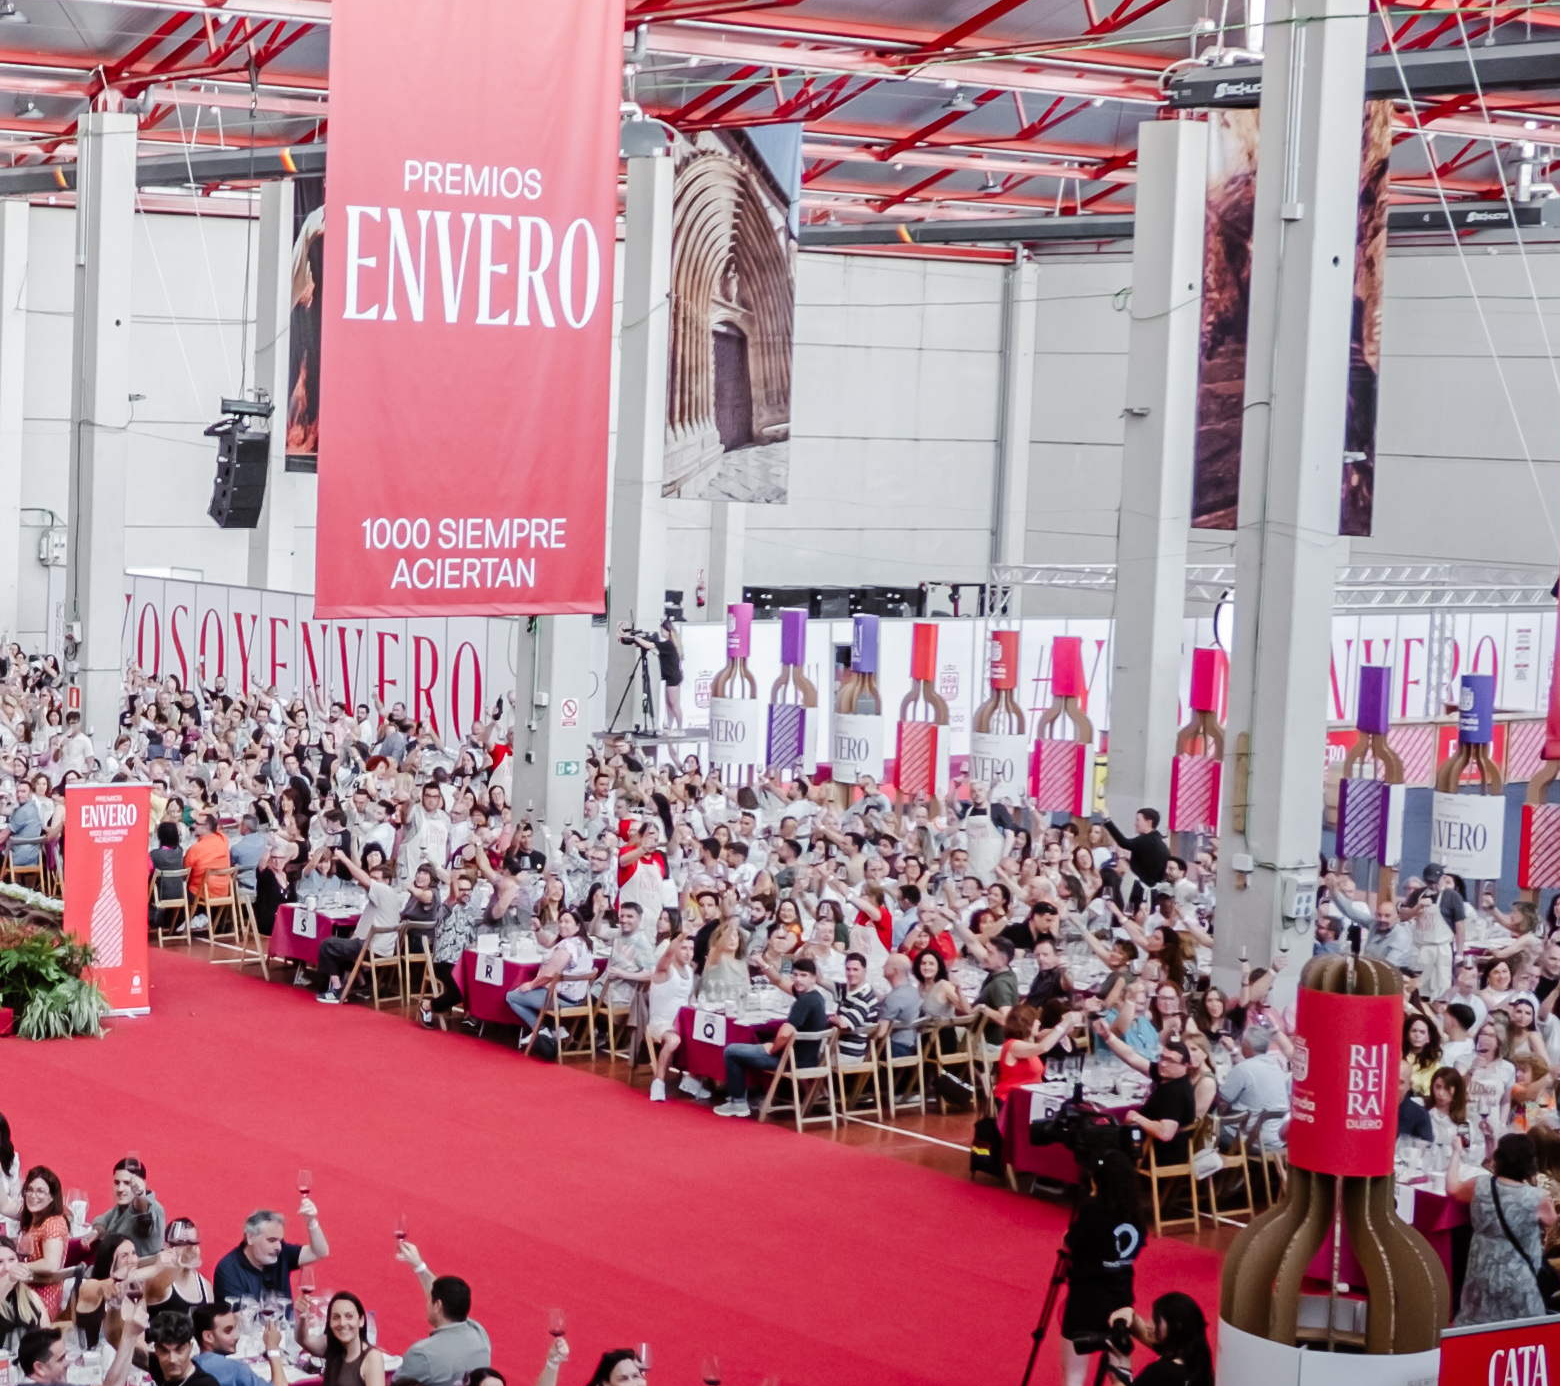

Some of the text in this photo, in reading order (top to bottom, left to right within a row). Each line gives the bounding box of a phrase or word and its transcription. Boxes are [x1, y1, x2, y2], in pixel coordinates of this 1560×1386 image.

[403, 159, 542, 200] PREMIOS
[342, 205, 601, 329] ENVERO
[361, 517, 567, 550] 1000 SIEMPRE
[390, 556, 536, 591] ACIERTAN
[81, 803, 137, 828] ENVERO
[300, 918, 307, 933] S
[485, 964, 493, 979] R
[703, 1023, 715, 1040] Q
